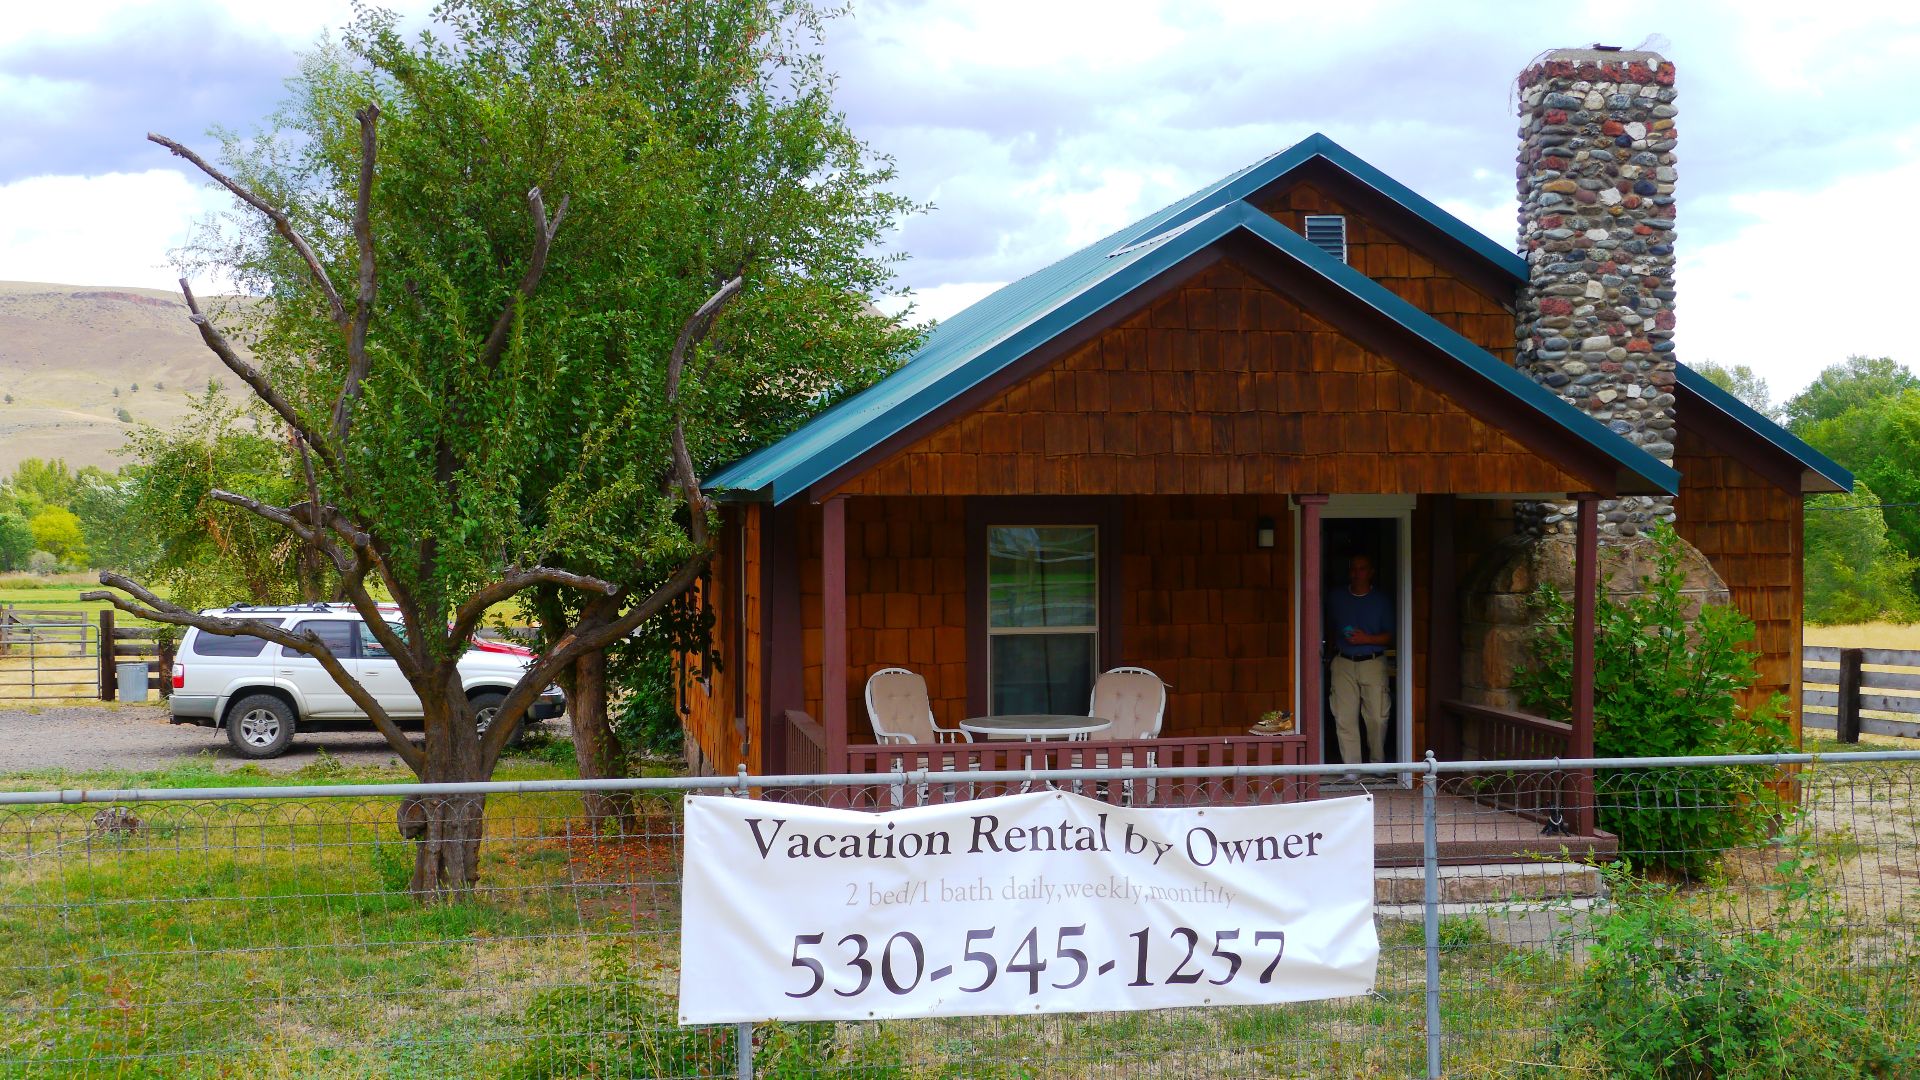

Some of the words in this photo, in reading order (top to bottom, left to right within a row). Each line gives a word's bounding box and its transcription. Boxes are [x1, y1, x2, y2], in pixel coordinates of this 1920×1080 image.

[745, 818, 952, 860] Vacation
[967, 814, 1111, 854] Rental
[1124, 822, 1174, 866] by
[1185, 827, 1323, 867] Owner
[845, 882, 859, 907] 2
[868, 880, 929, 907] bed/1
[940, 876, 994, 902] bath
[784, 923, 1286, 999] 530-545-1257
